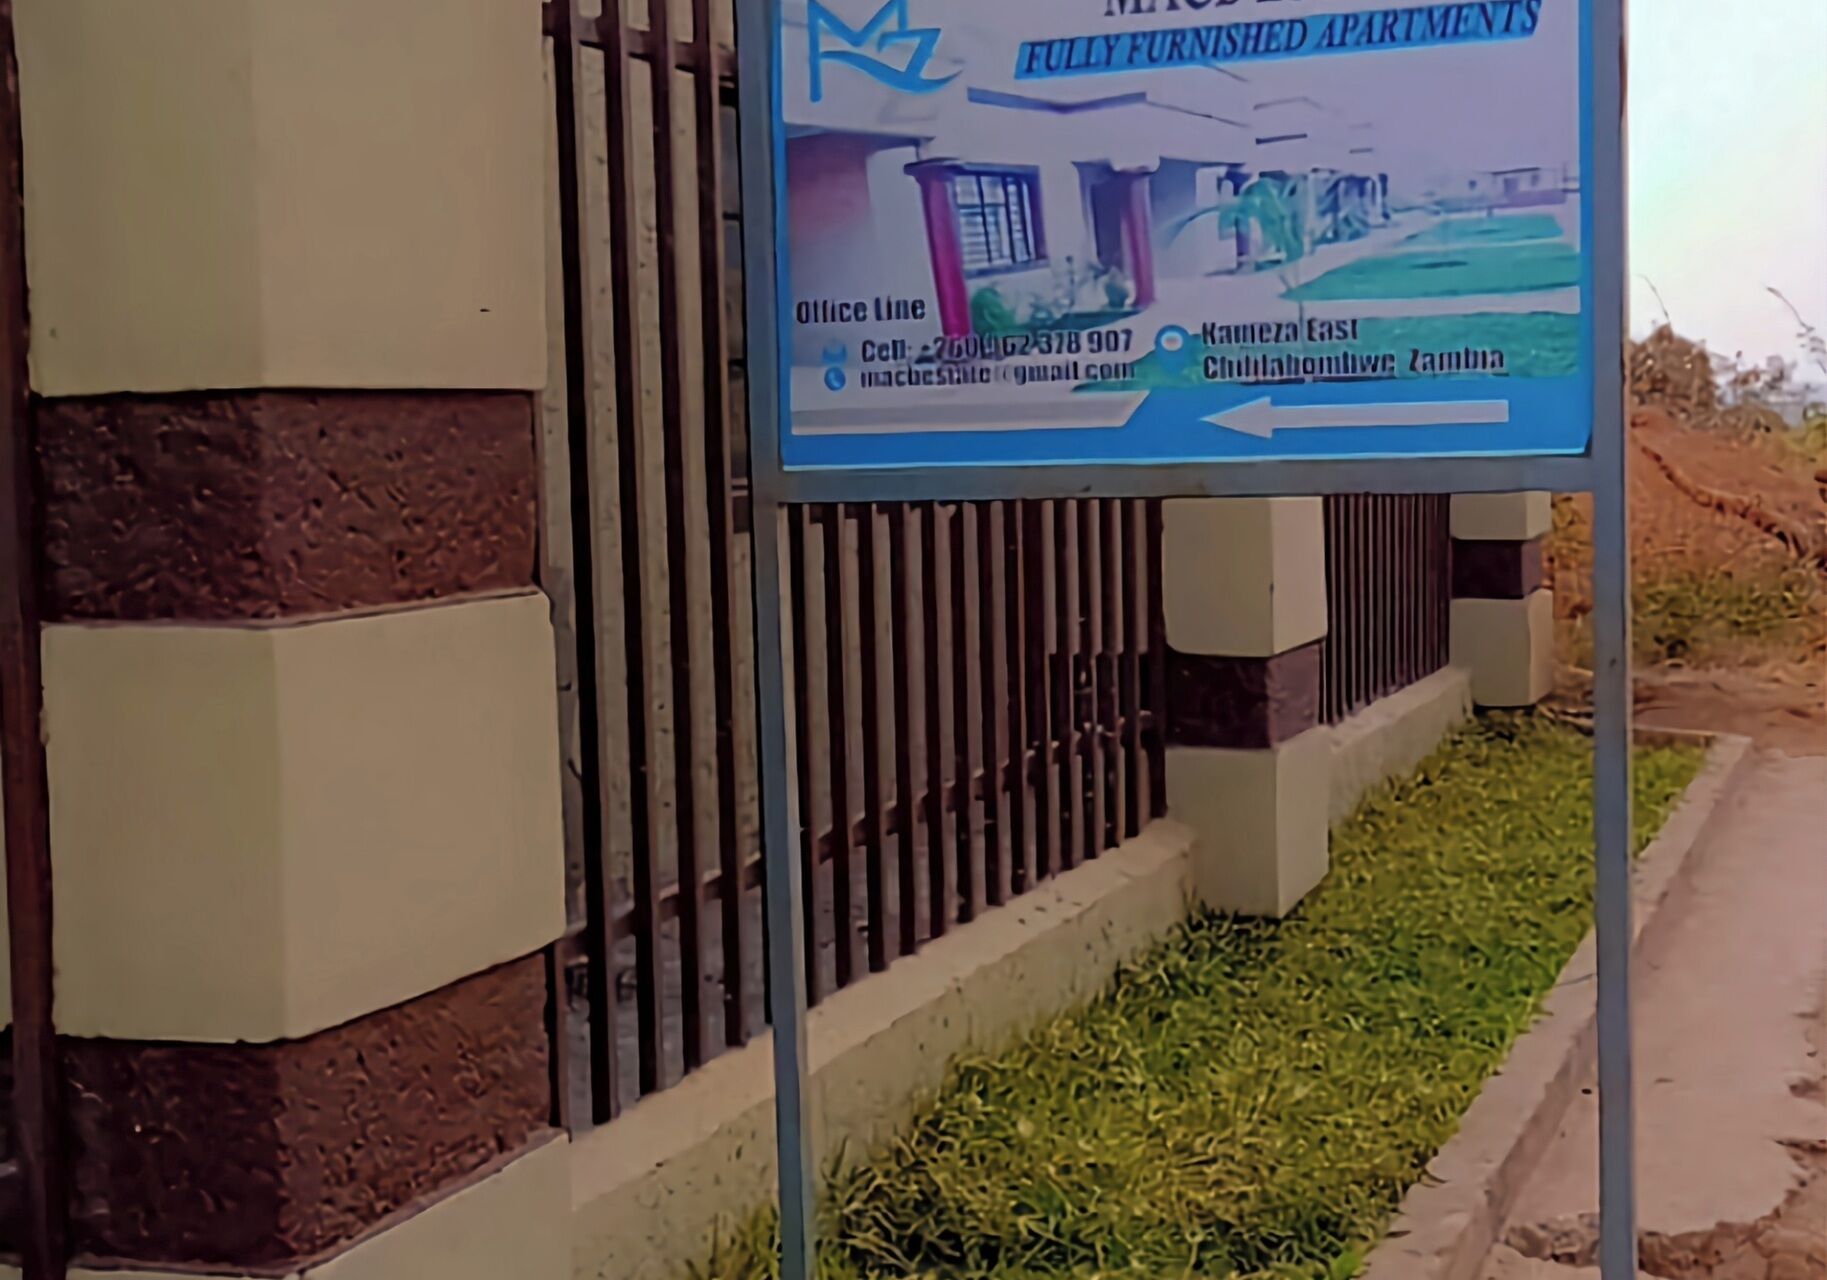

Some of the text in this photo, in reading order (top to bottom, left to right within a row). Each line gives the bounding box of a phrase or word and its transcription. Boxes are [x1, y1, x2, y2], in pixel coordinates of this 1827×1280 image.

[1025, 33, 1121, 74] FULLY
[1127, 19, 1308, 66] FURNISHED
[796, 296, 926, 324] Office Line
[1038, 329, 1082, 356] 378
[1087, 328, 1133, 354] 907
[1306, 318, 1359, 342] East
[1408, 346, 1506, 373] Zambia
